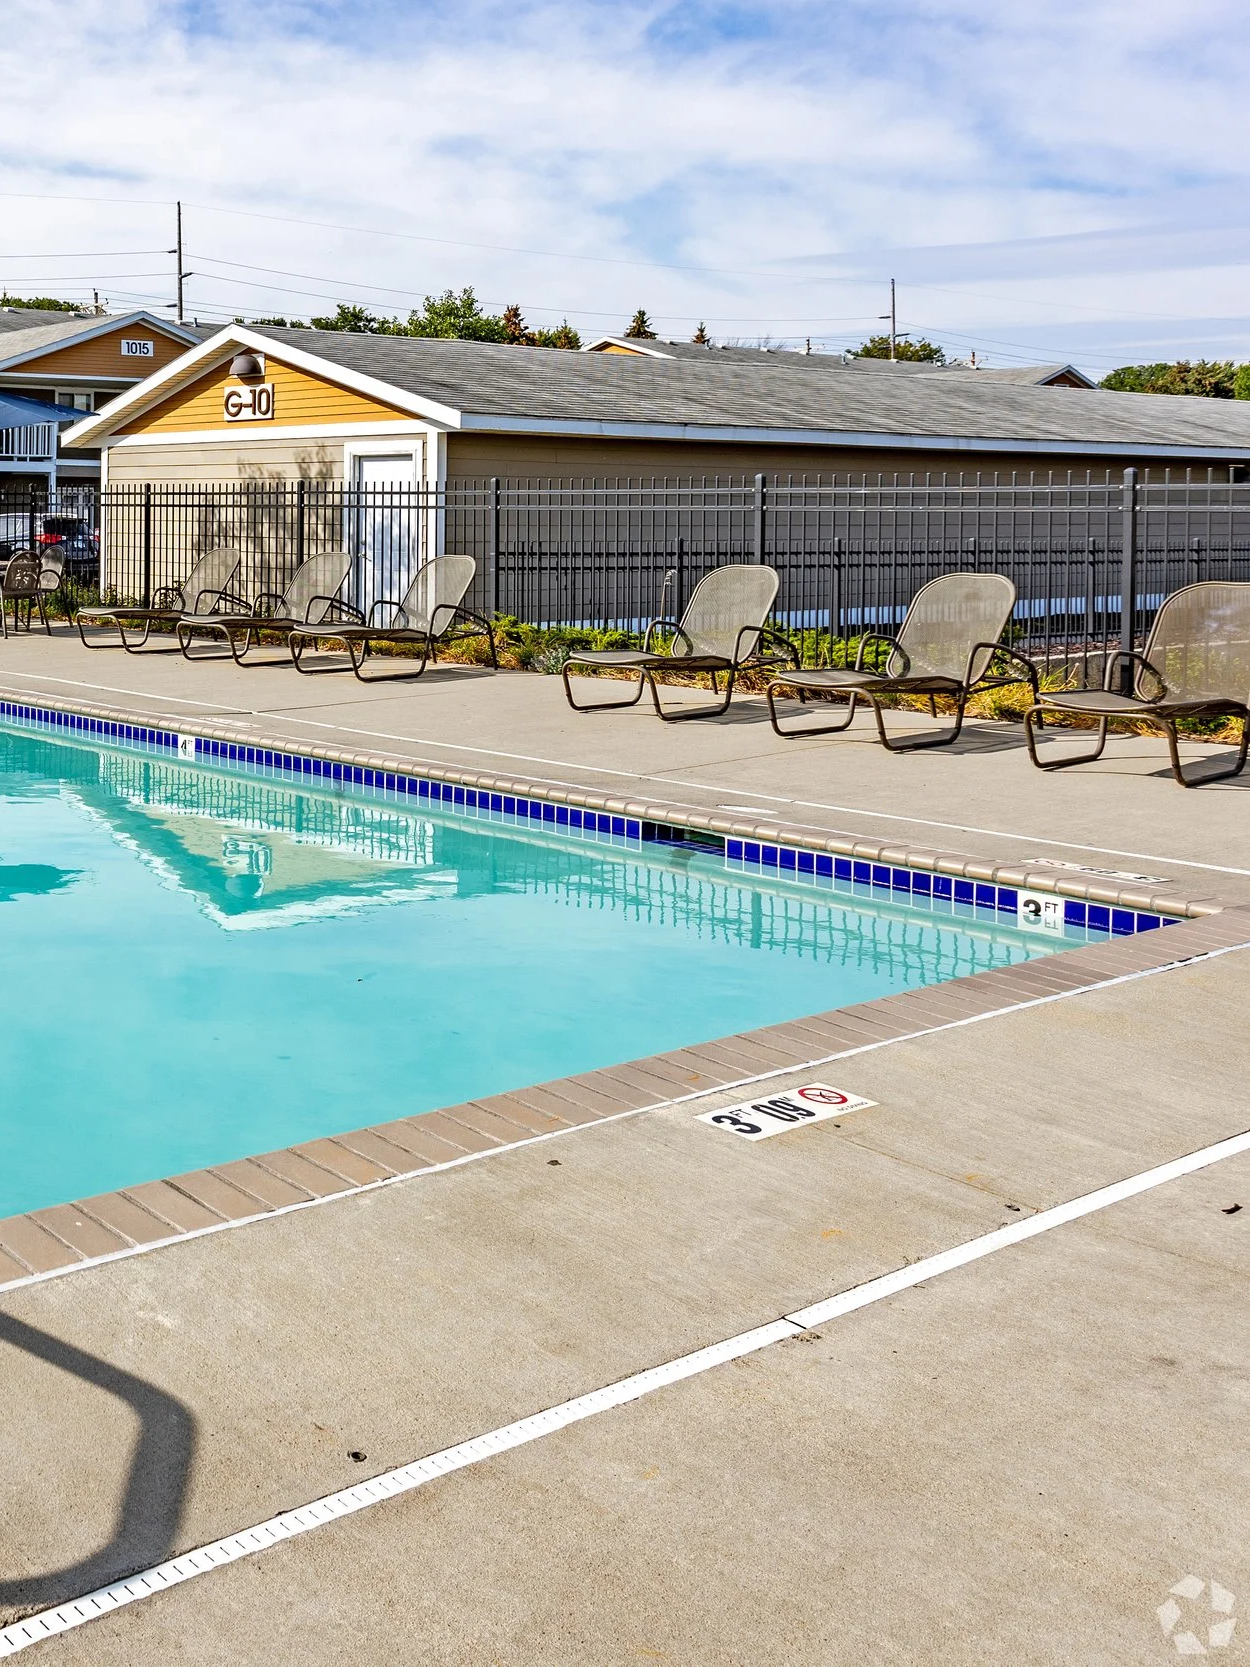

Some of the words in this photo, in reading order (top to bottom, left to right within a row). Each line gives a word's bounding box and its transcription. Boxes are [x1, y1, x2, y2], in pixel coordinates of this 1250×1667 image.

[126, 342, 150, 355] 1015
[224, 387, 271, 418] G-10
[1023, 899, 1042, 917] 3
[1045, 901, 1059, 915] FT
[728, 1107, 752, 1119] FT
[711, 1114, 762, 1134] 3
